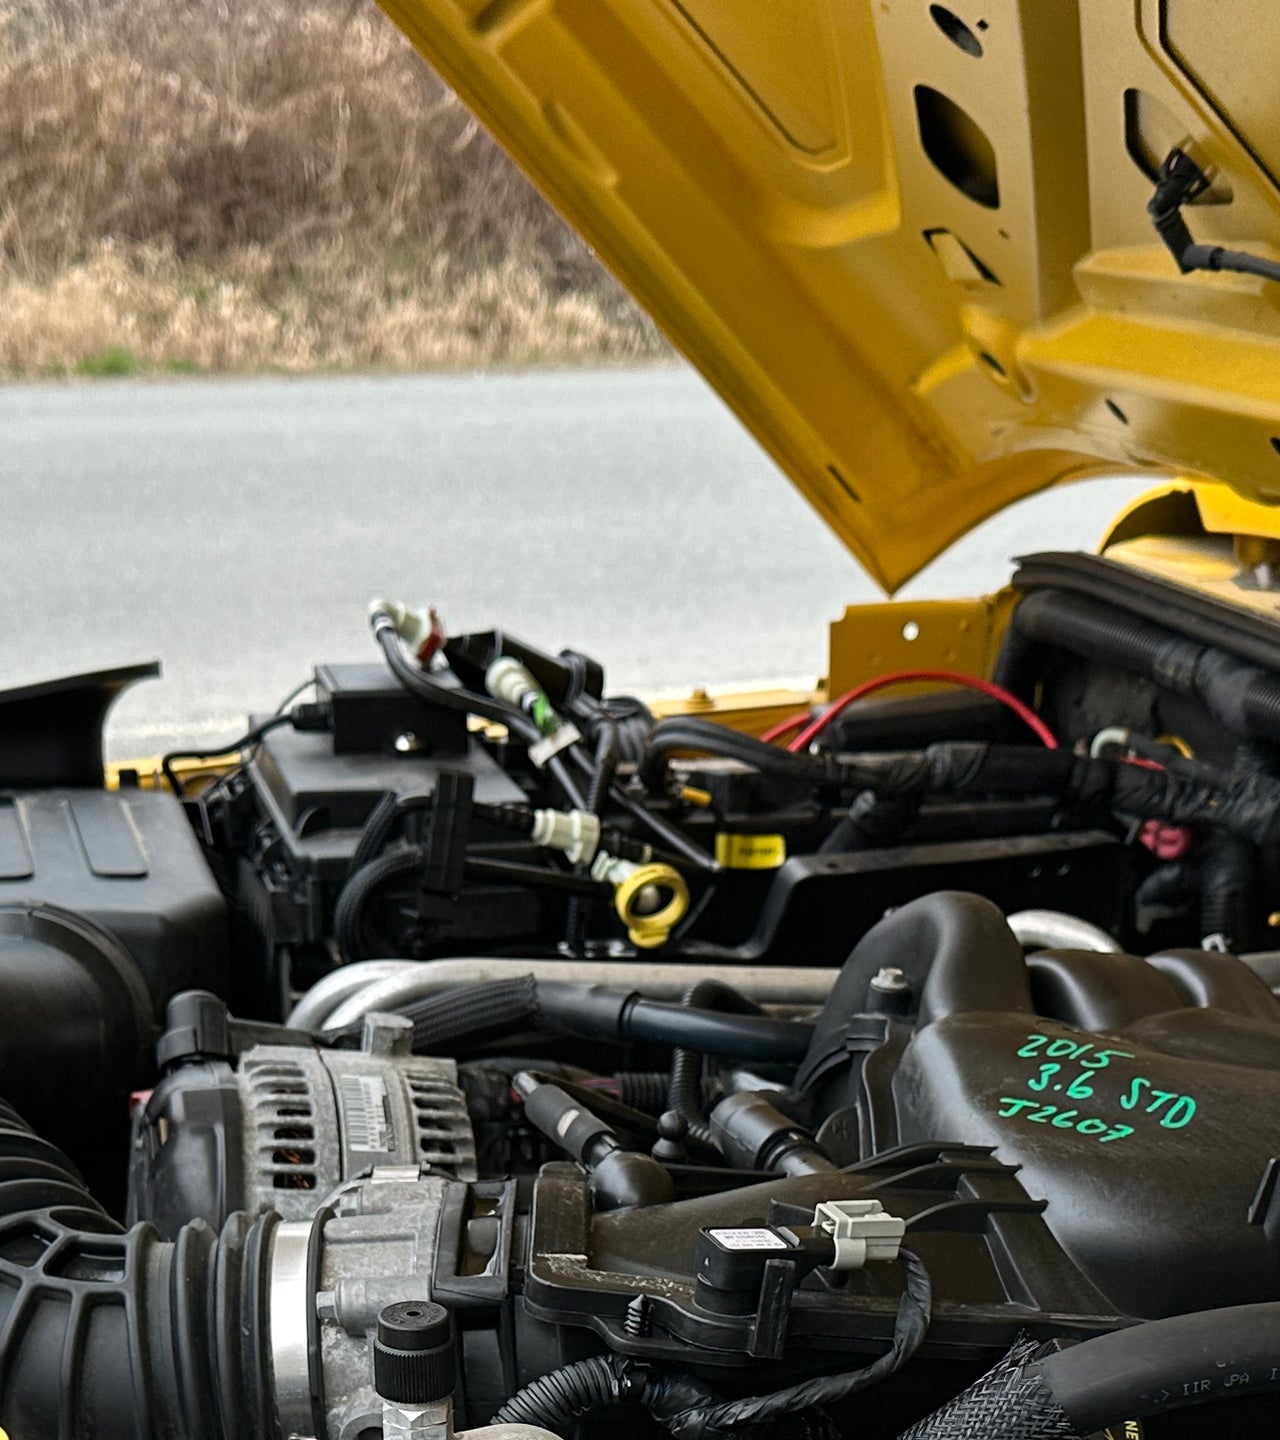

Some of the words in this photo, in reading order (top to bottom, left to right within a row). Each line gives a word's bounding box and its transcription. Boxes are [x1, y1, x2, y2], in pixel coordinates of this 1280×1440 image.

[1017, 1034, 1136, 1069] 2015
[1027, 1063, 1094, 1099] 3.6
[1120, 1076, 1197, 1129] STD
[998, 1097, 1134, 1142] J2607
